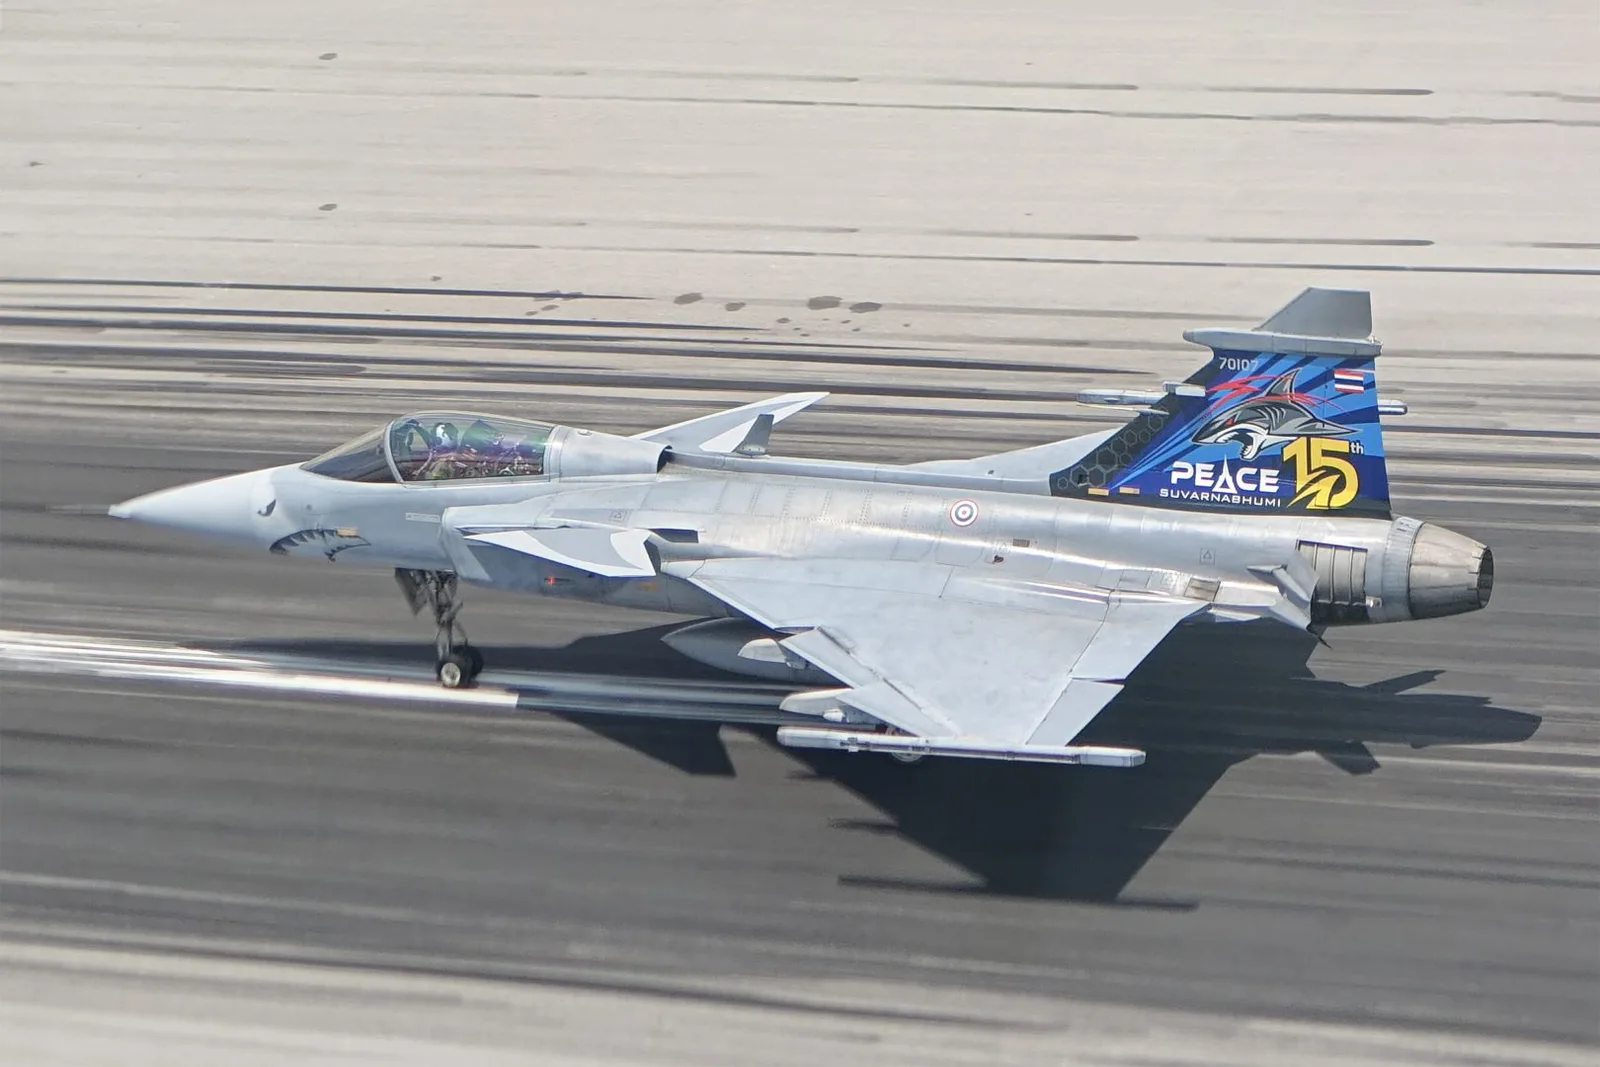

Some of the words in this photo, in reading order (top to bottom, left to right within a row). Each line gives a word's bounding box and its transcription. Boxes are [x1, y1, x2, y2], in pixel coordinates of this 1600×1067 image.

[1219, 357, 1258, 371] 70107
[1171, 455, 1280, 493] PEACE
[1160, 488, 1281, 507] SUVARNABHUMI
